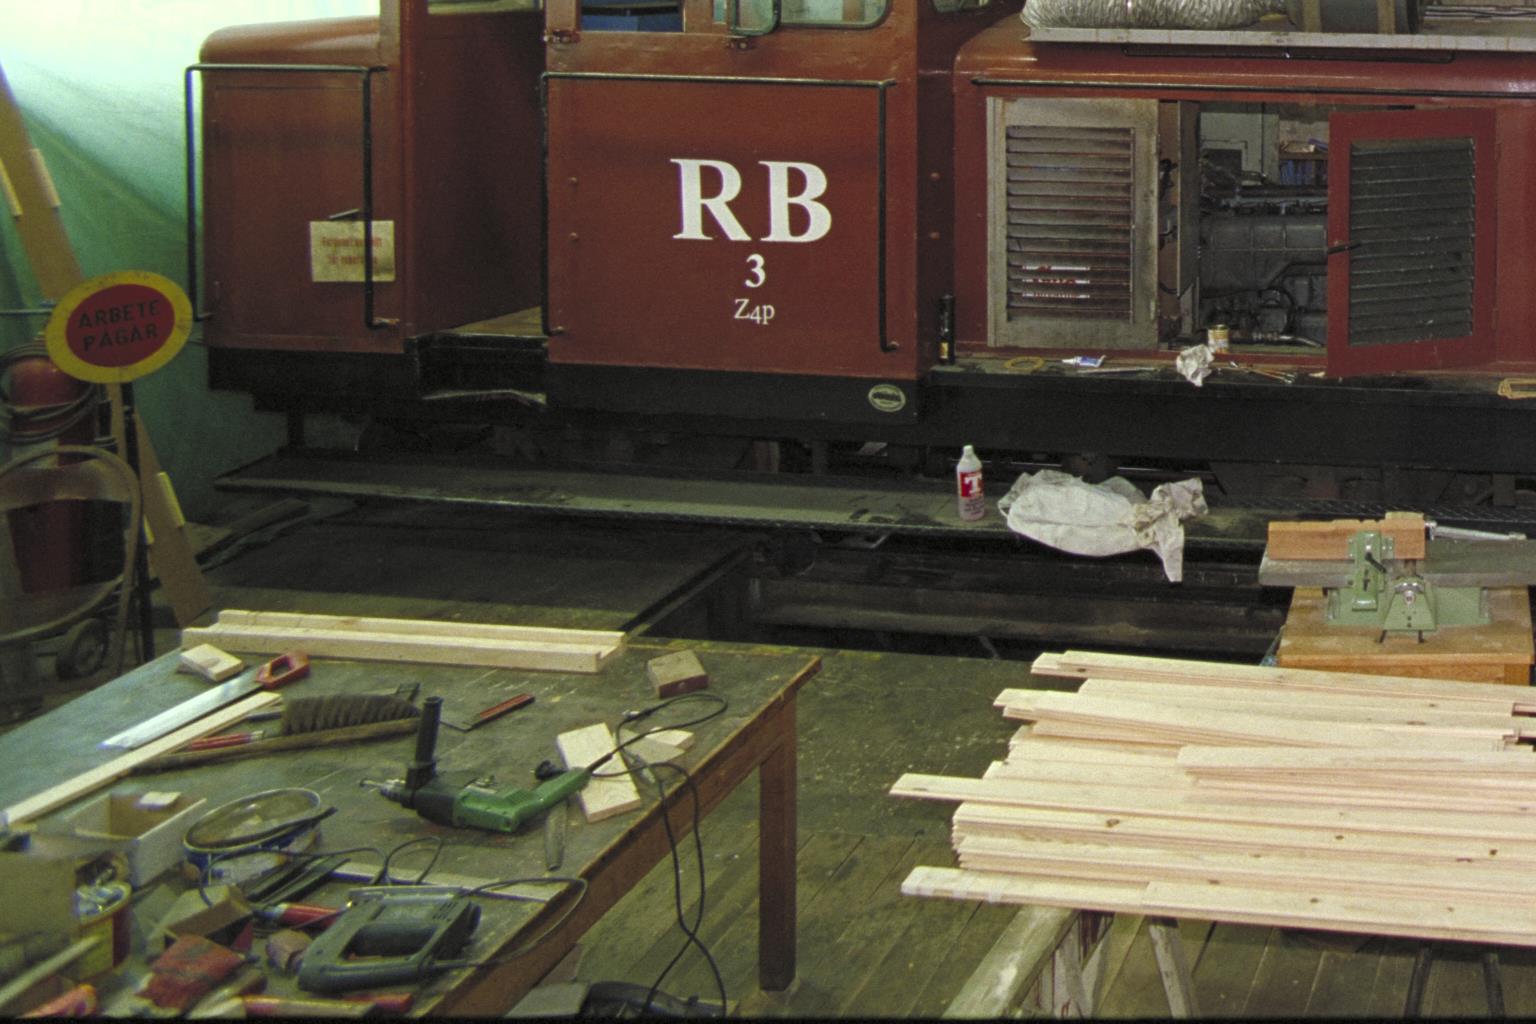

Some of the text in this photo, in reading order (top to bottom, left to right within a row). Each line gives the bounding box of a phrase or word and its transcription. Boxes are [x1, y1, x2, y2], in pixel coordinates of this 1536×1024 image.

[669, 157, 833, 244] RB
[744, 253, 767, 289] 3
[78, 299, 160, 328] ARBETE
[732, 297, 776, 326] Z4p
